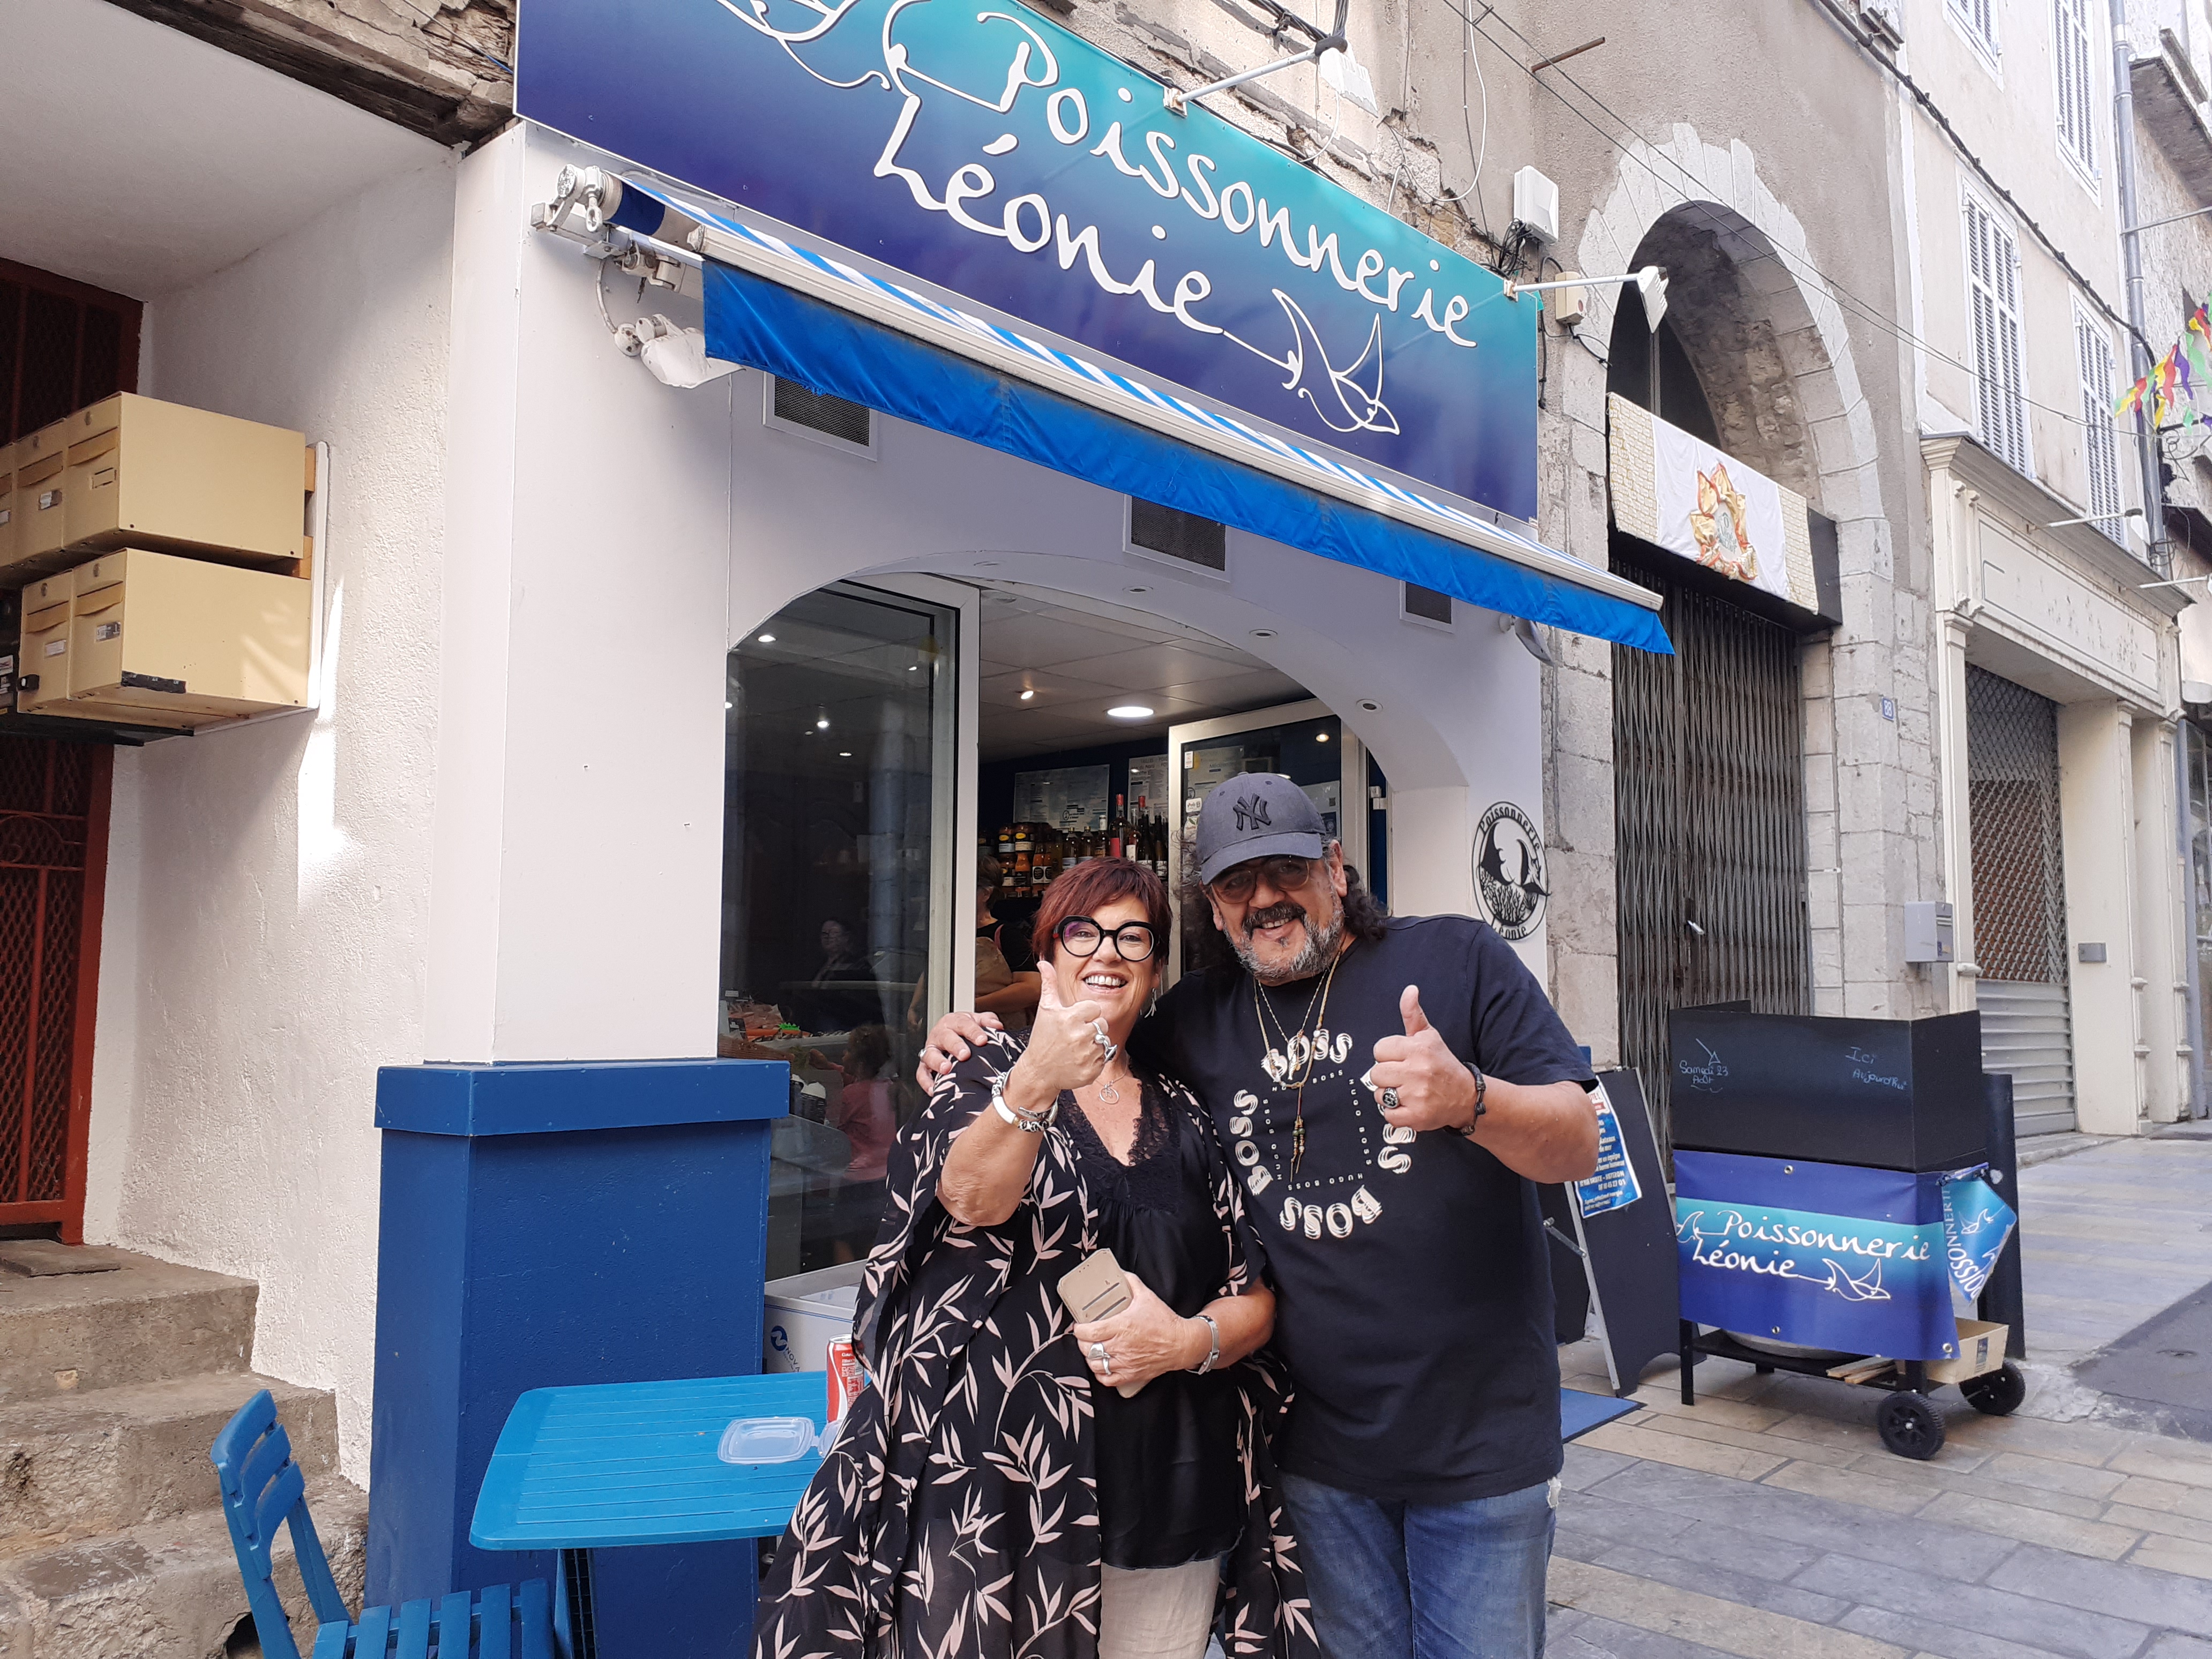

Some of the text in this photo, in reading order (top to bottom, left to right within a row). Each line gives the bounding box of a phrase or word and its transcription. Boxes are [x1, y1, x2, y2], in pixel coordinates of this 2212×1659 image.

[977, 11, 1477, 348] Poissonnerie
[875, 95, 1224, 334] Léonie
[1233, 793, 1272, 831] NY
[1479, 806, 1540, 852] Poissonnerie
[1261, 1029, 1353, 1082] BOSS
[1312, 1070, 1343, 1083] BOSS
[1229, 1089, 1274, 1195] BOSS
[1262, 1098, 1282, 1180] HUGO BOSS
[1349, 1079, 1372, 1165] HUGO BOSS
[1288, 1173, 1363, 1191] HUGO BOSS
[1279, 1185, 1383, 1239] BOSS
[1717, 1209, 1930, 1261] Poissonnerie
[1692, 1238, 1799, 1277] Léonie
